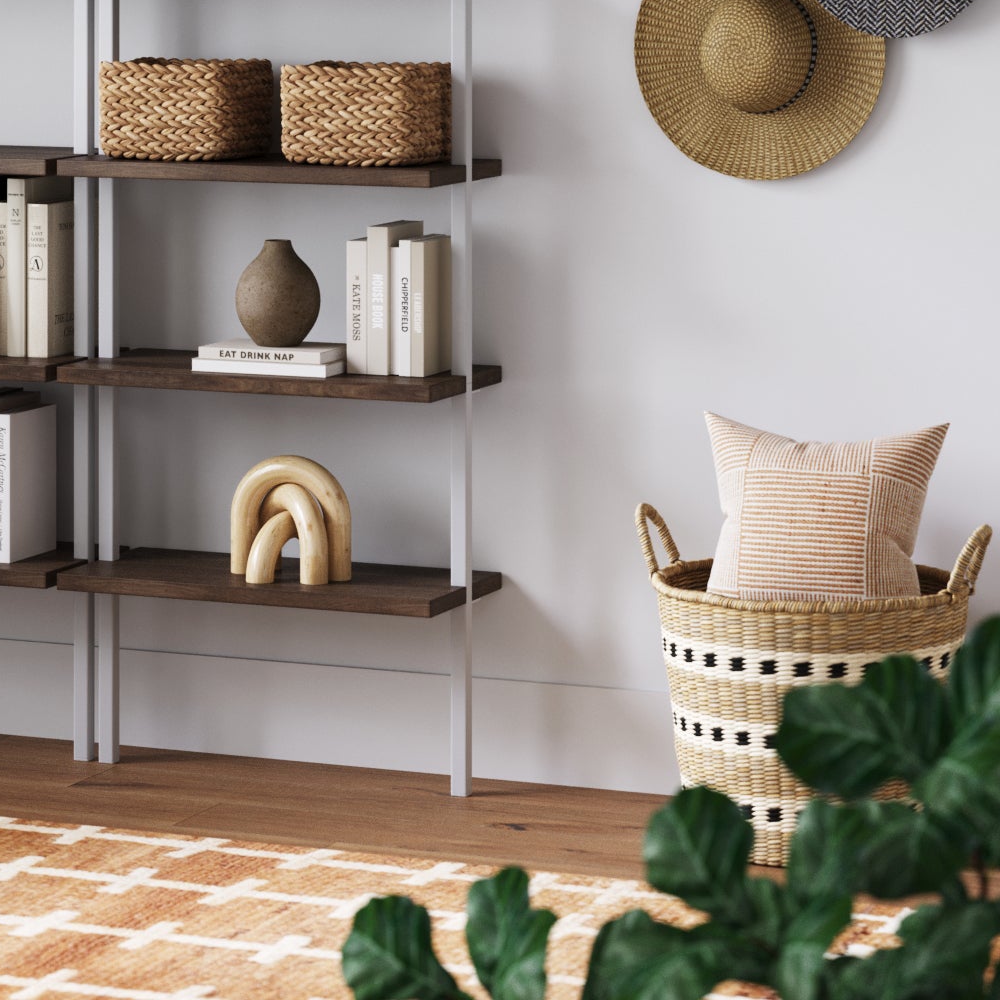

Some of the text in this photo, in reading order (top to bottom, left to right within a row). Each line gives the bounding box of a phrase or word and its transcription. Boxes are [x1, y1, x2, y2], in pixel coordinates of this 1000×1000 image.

[12, 208, 20, 217] N
[352, 284, 361, 341] KATE MOSS
[372, 273, 384, 329] HOUSE BOOK
[401, 277, 409, 333] CHIPPERFIELD
[219, 350, 295, 361] EAT DRINK NAP
